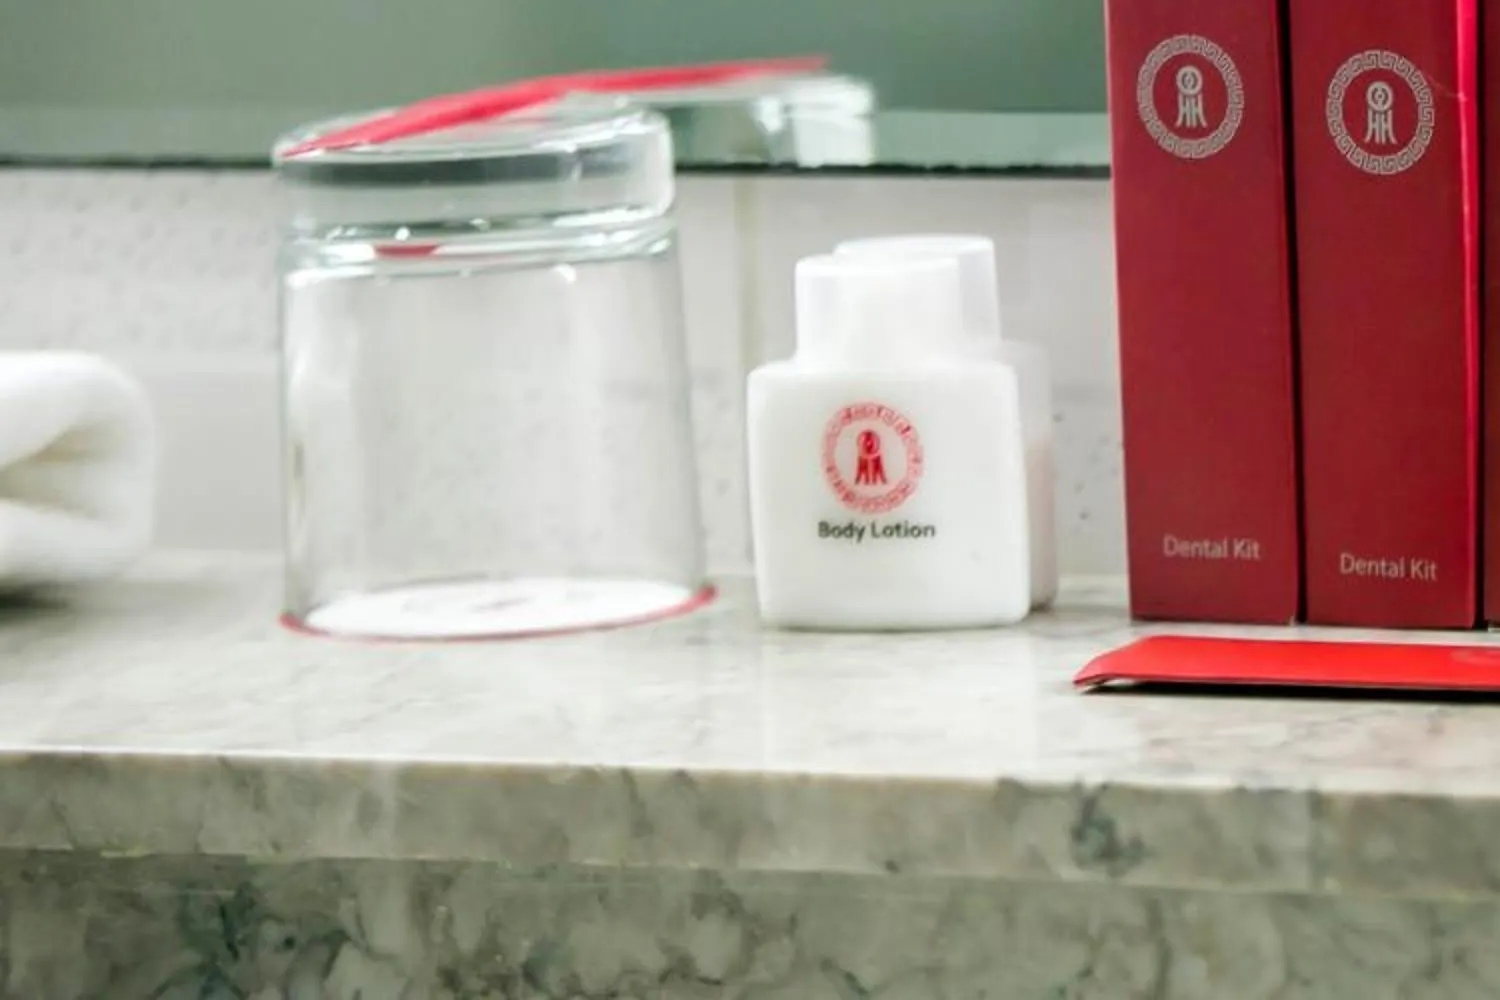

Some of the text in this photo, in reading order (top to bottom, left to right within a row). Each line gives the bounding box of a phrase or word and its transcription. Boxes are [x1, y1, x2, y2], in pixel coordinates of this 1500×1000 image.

[817, 519, 937, 543] Body Lotion
[1162, 533, 1262, 561] Dental Kit
[1340, 551, 1438, 582] Dental Kit
